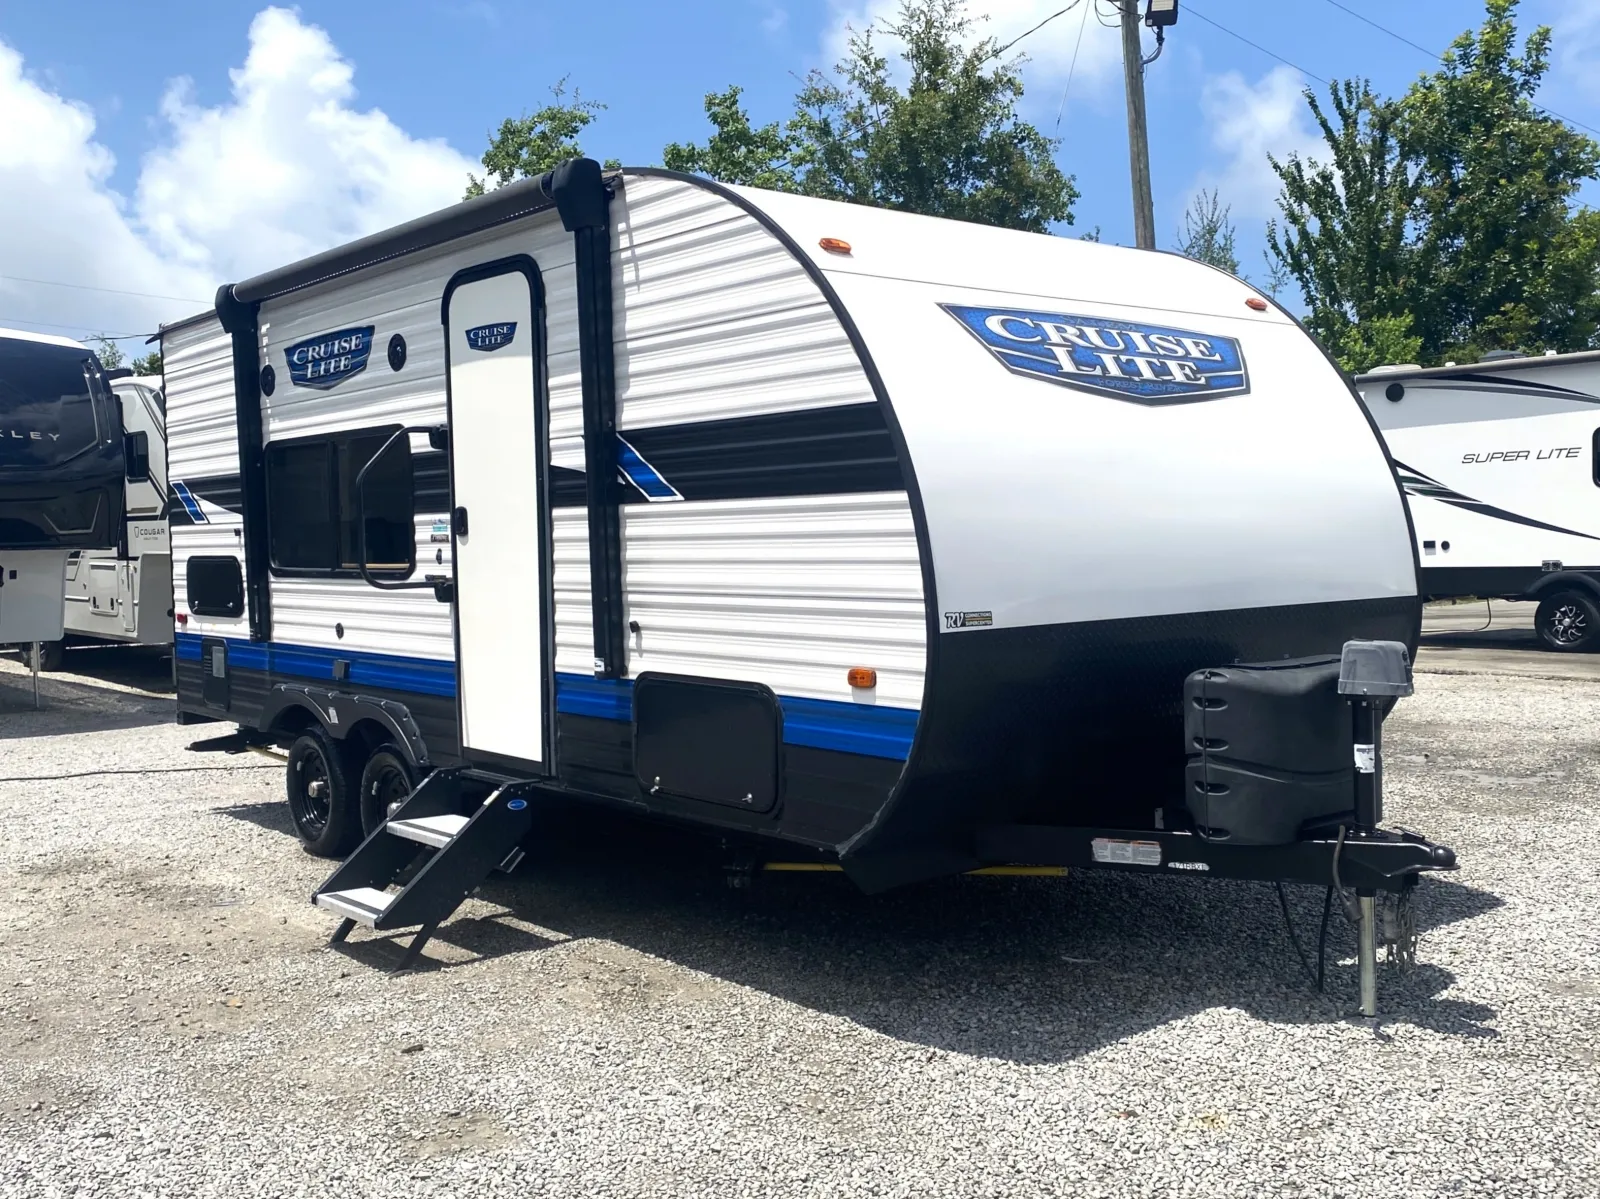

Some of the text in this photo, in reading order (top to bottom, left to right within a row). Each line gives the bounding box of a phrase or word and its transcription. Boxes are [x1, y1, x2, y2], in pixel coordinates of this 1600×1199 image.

[470, 325, 511, 339] CRUISE
[478, 335, 505, 346] LITE
[984, 314, 1222, 362] CRUISE
[293, 334, 363, 365] CRUISE
[306, 355, 352, 379] LITE
[1043, 344, 1207, 385] LITE
[1461, 446, 1583, 464] SUPER LITE
[140, 528, 165, 536] COUGAR
[945, 611, 964, 628] RV
